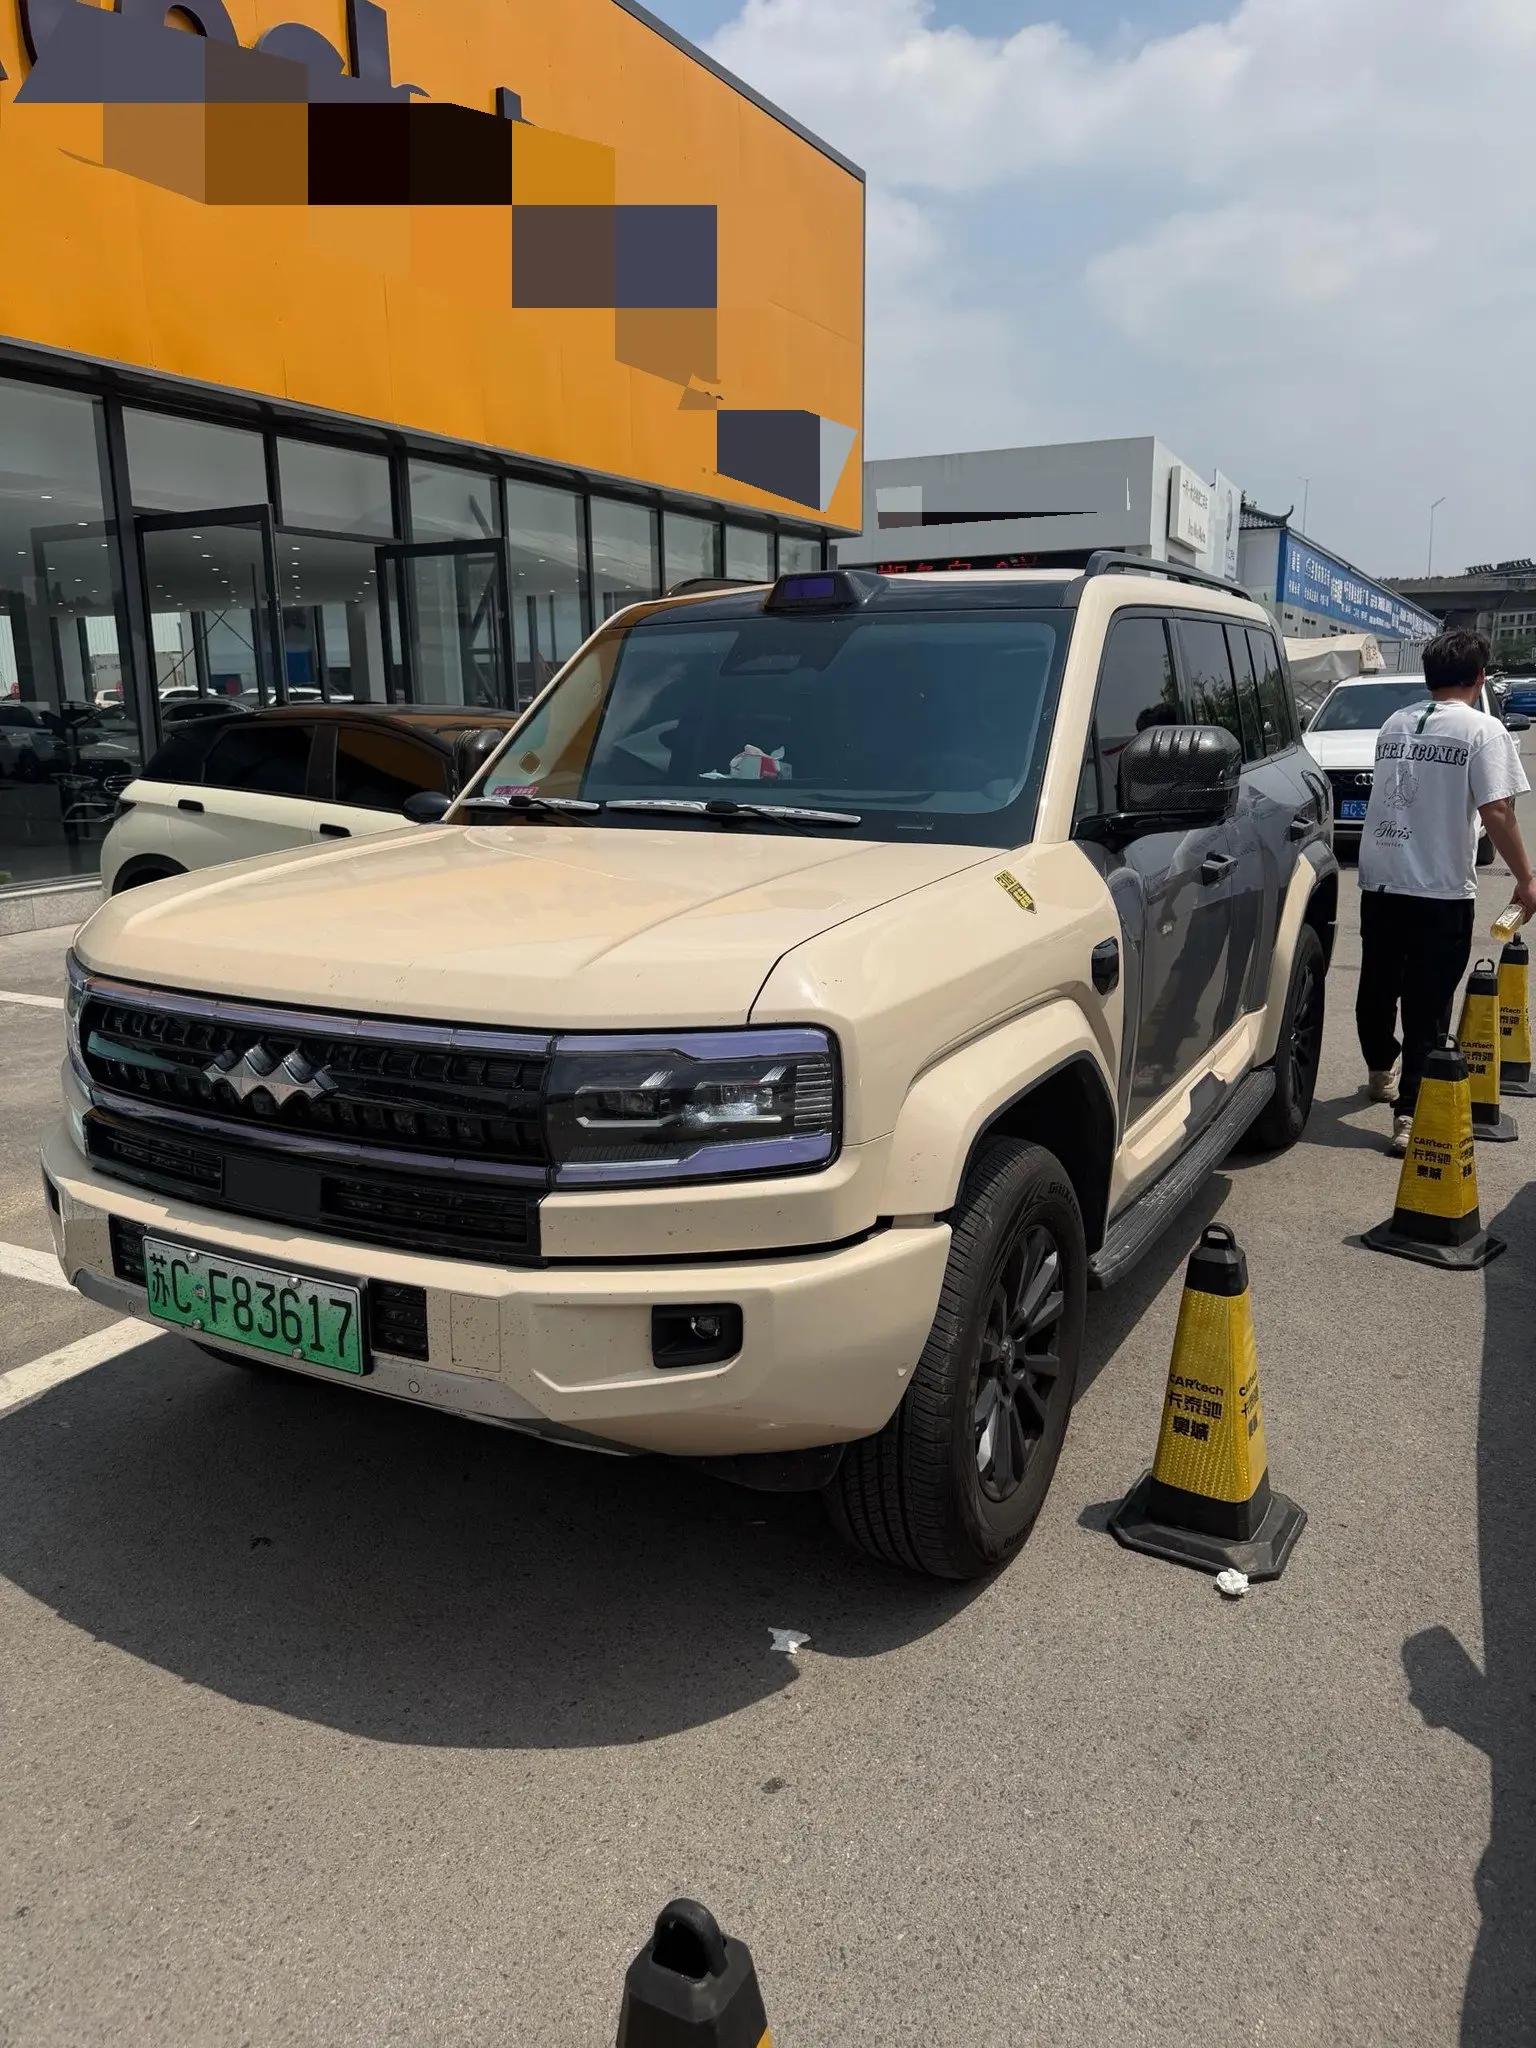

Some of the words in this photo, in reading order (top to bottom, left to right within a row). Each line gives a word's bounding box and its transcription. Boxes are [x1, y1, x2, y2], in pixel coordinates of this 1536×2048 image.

[1406, 743, 1469, 766] ICONIC
[1412, 1148, 1451, 1165] 卡泰驰
[1166, 1390, 1223, 1420] 卡泰驰
